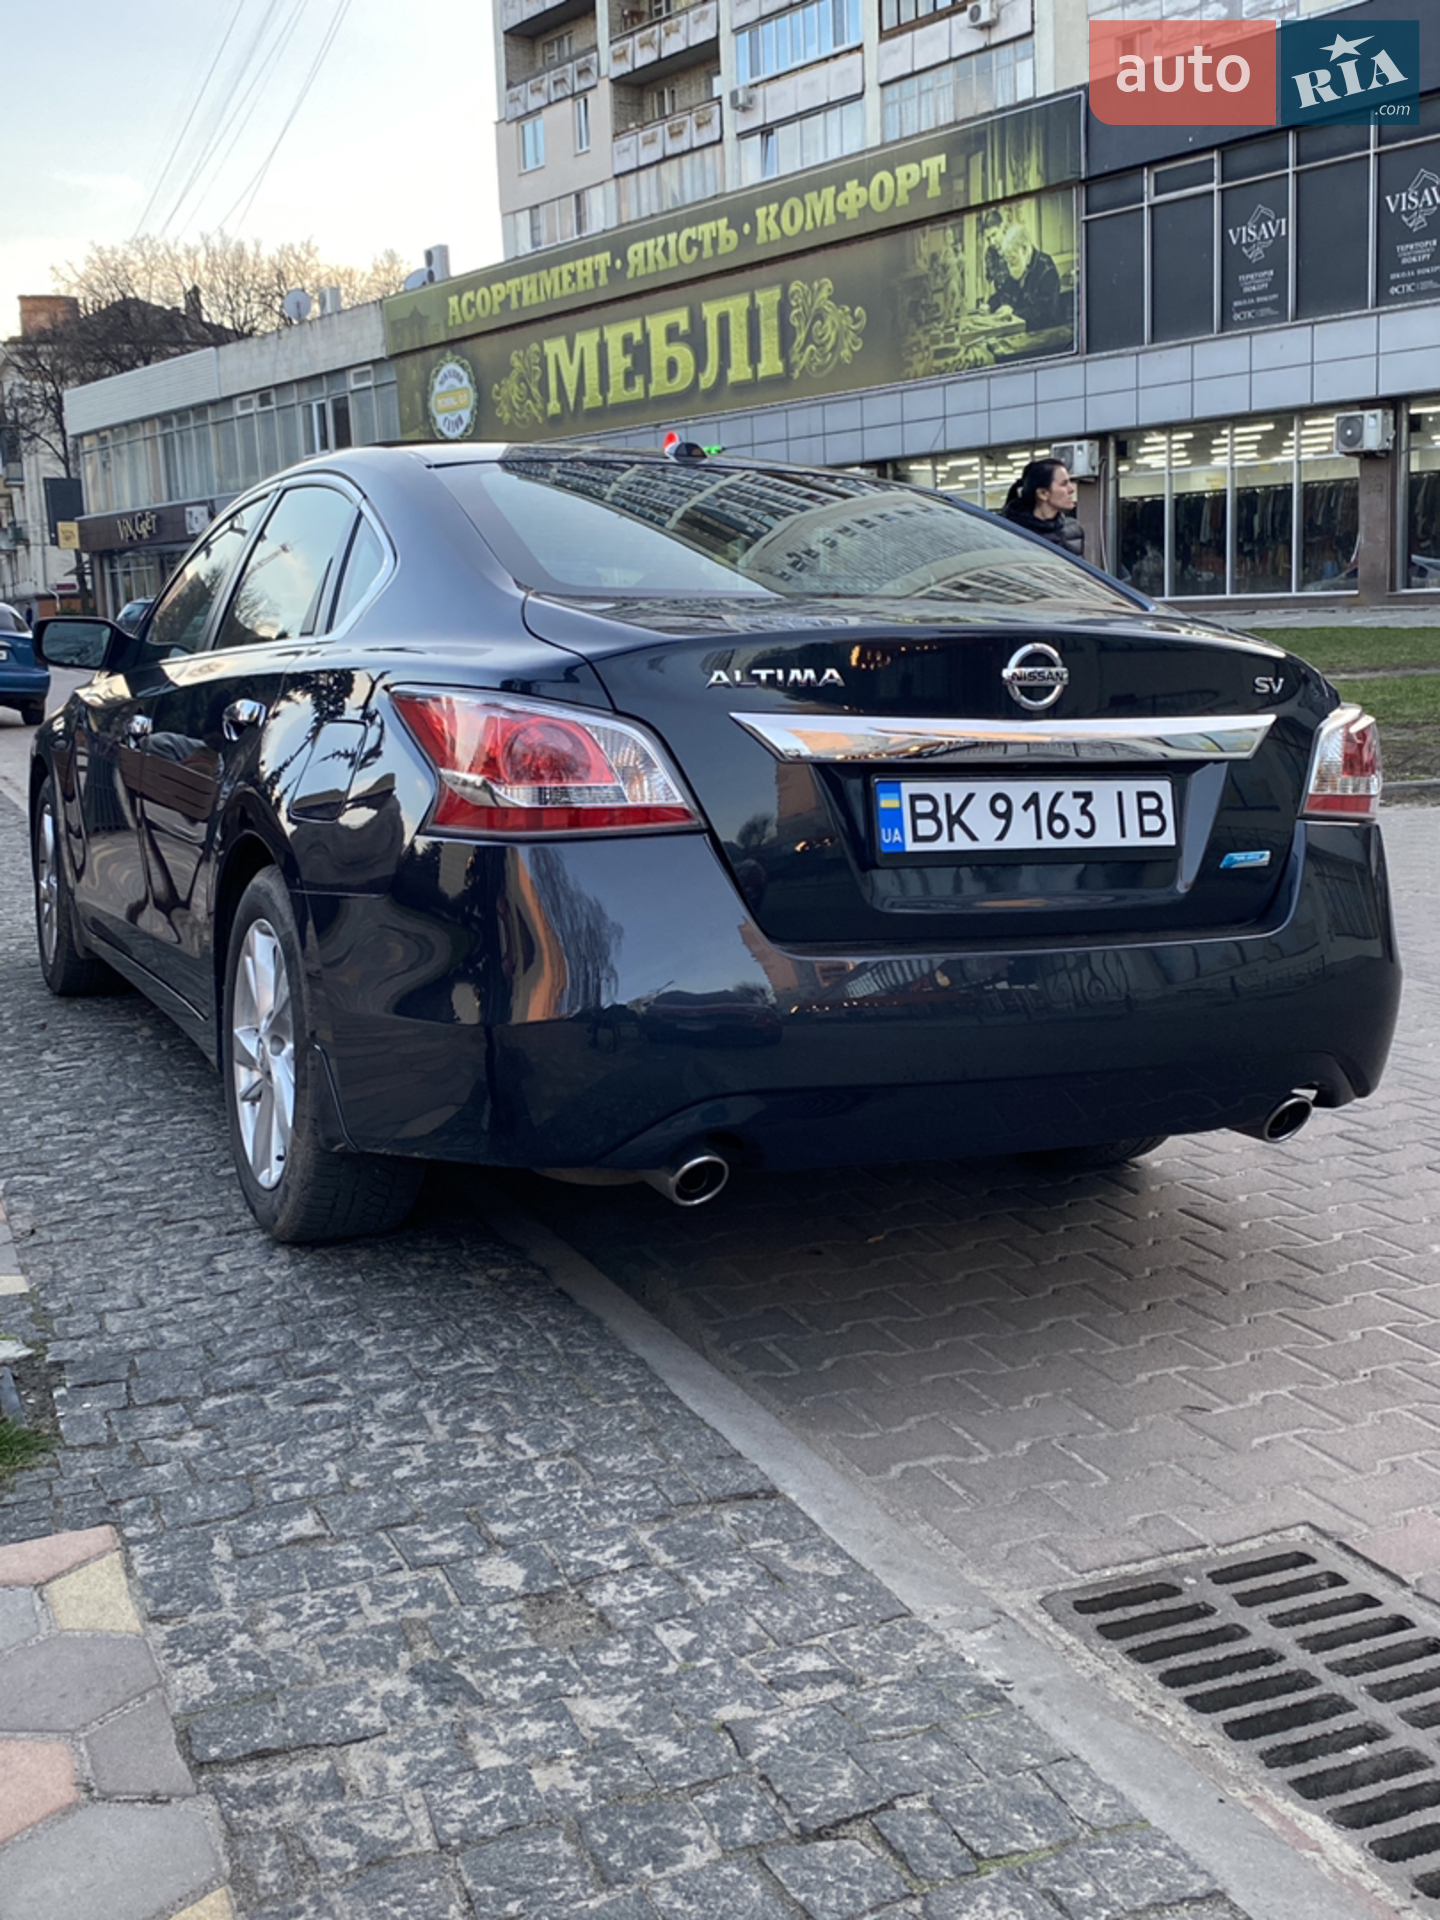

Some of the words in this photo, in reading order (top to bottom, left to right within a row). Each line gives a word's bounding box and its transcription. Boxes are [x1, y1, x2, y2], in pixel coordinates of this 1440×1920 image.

[448, 252, 612, 326] АСОРТИМЕНТ
[626, 217, 738, 279] ЯКІСТЬ
[755, 154, 946, 245] КОМФОРТ
[1228, 218, 1287, 245] VISAVI
[543, 285, 784, 417] МЕБЛІ
[705, 667, 844, 689] ALTIMA
[1012, 671, 1065, 683] NISSAN
[1254, 676, 1284, 694] SV
[881, 828, 902, 843] UA
[908, 792, 980, 843] BK
[989, 791, 1097, 841] 9163
[1117, 791, 1167, 839] IB
